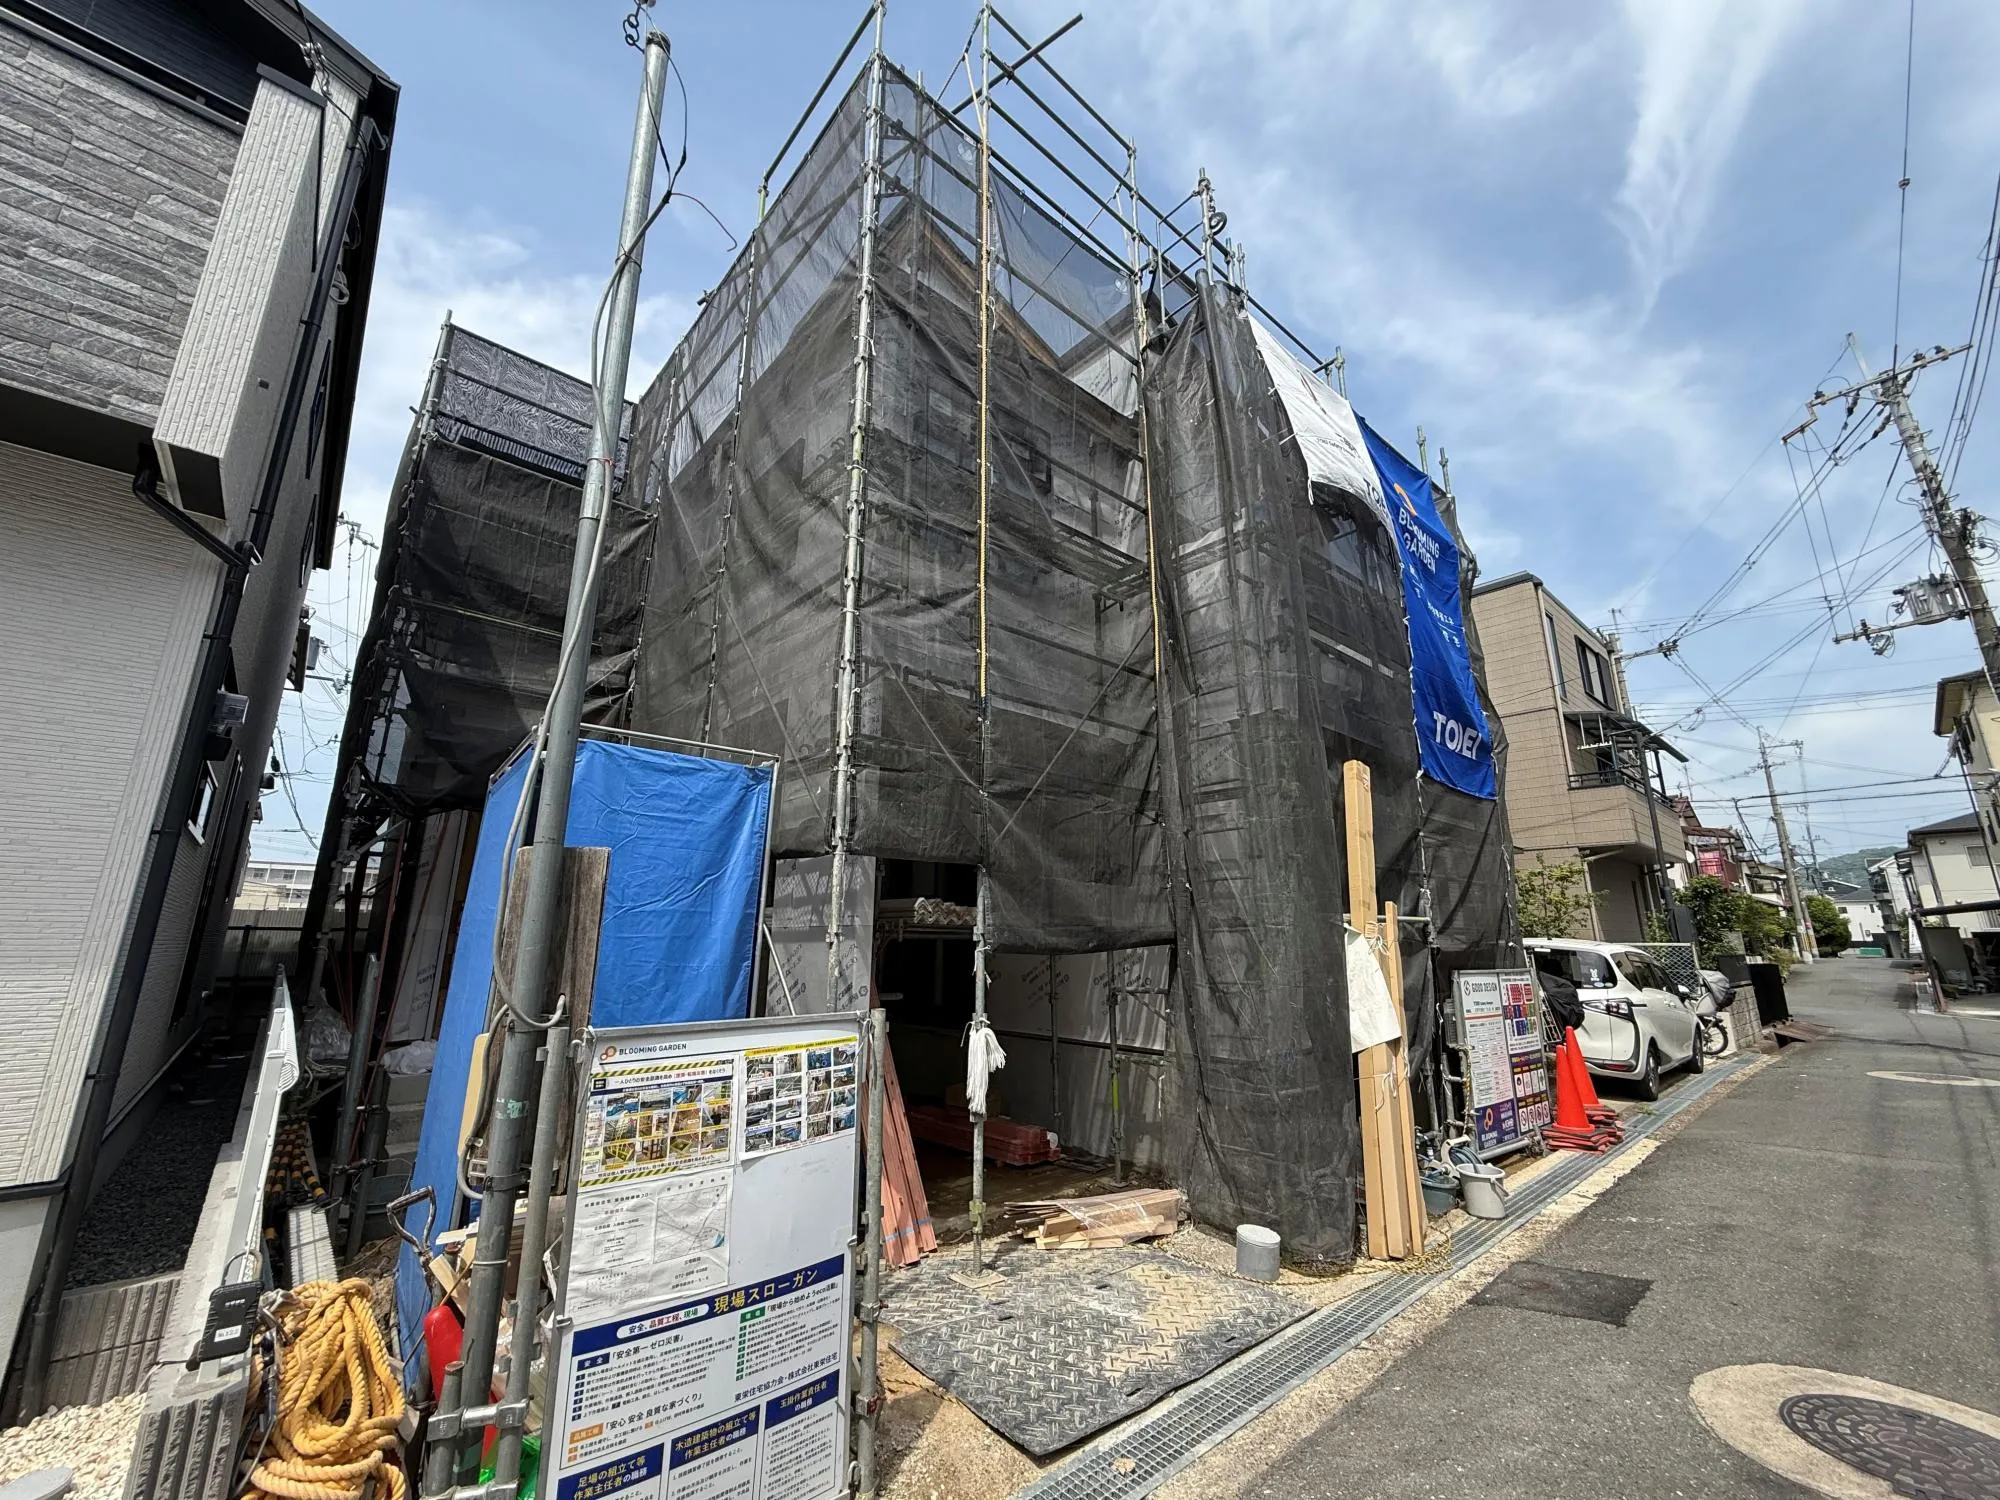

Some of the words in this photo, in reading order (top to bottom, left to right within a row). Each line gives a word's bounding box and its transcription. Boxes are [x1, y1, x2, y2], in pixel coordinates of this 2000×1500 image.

[619, 1046, 657, 1055] BLOOMING
[658, 1043, 687, 1052] GARDEN
[713, 1269, 818, 1314] 現場スローガン
